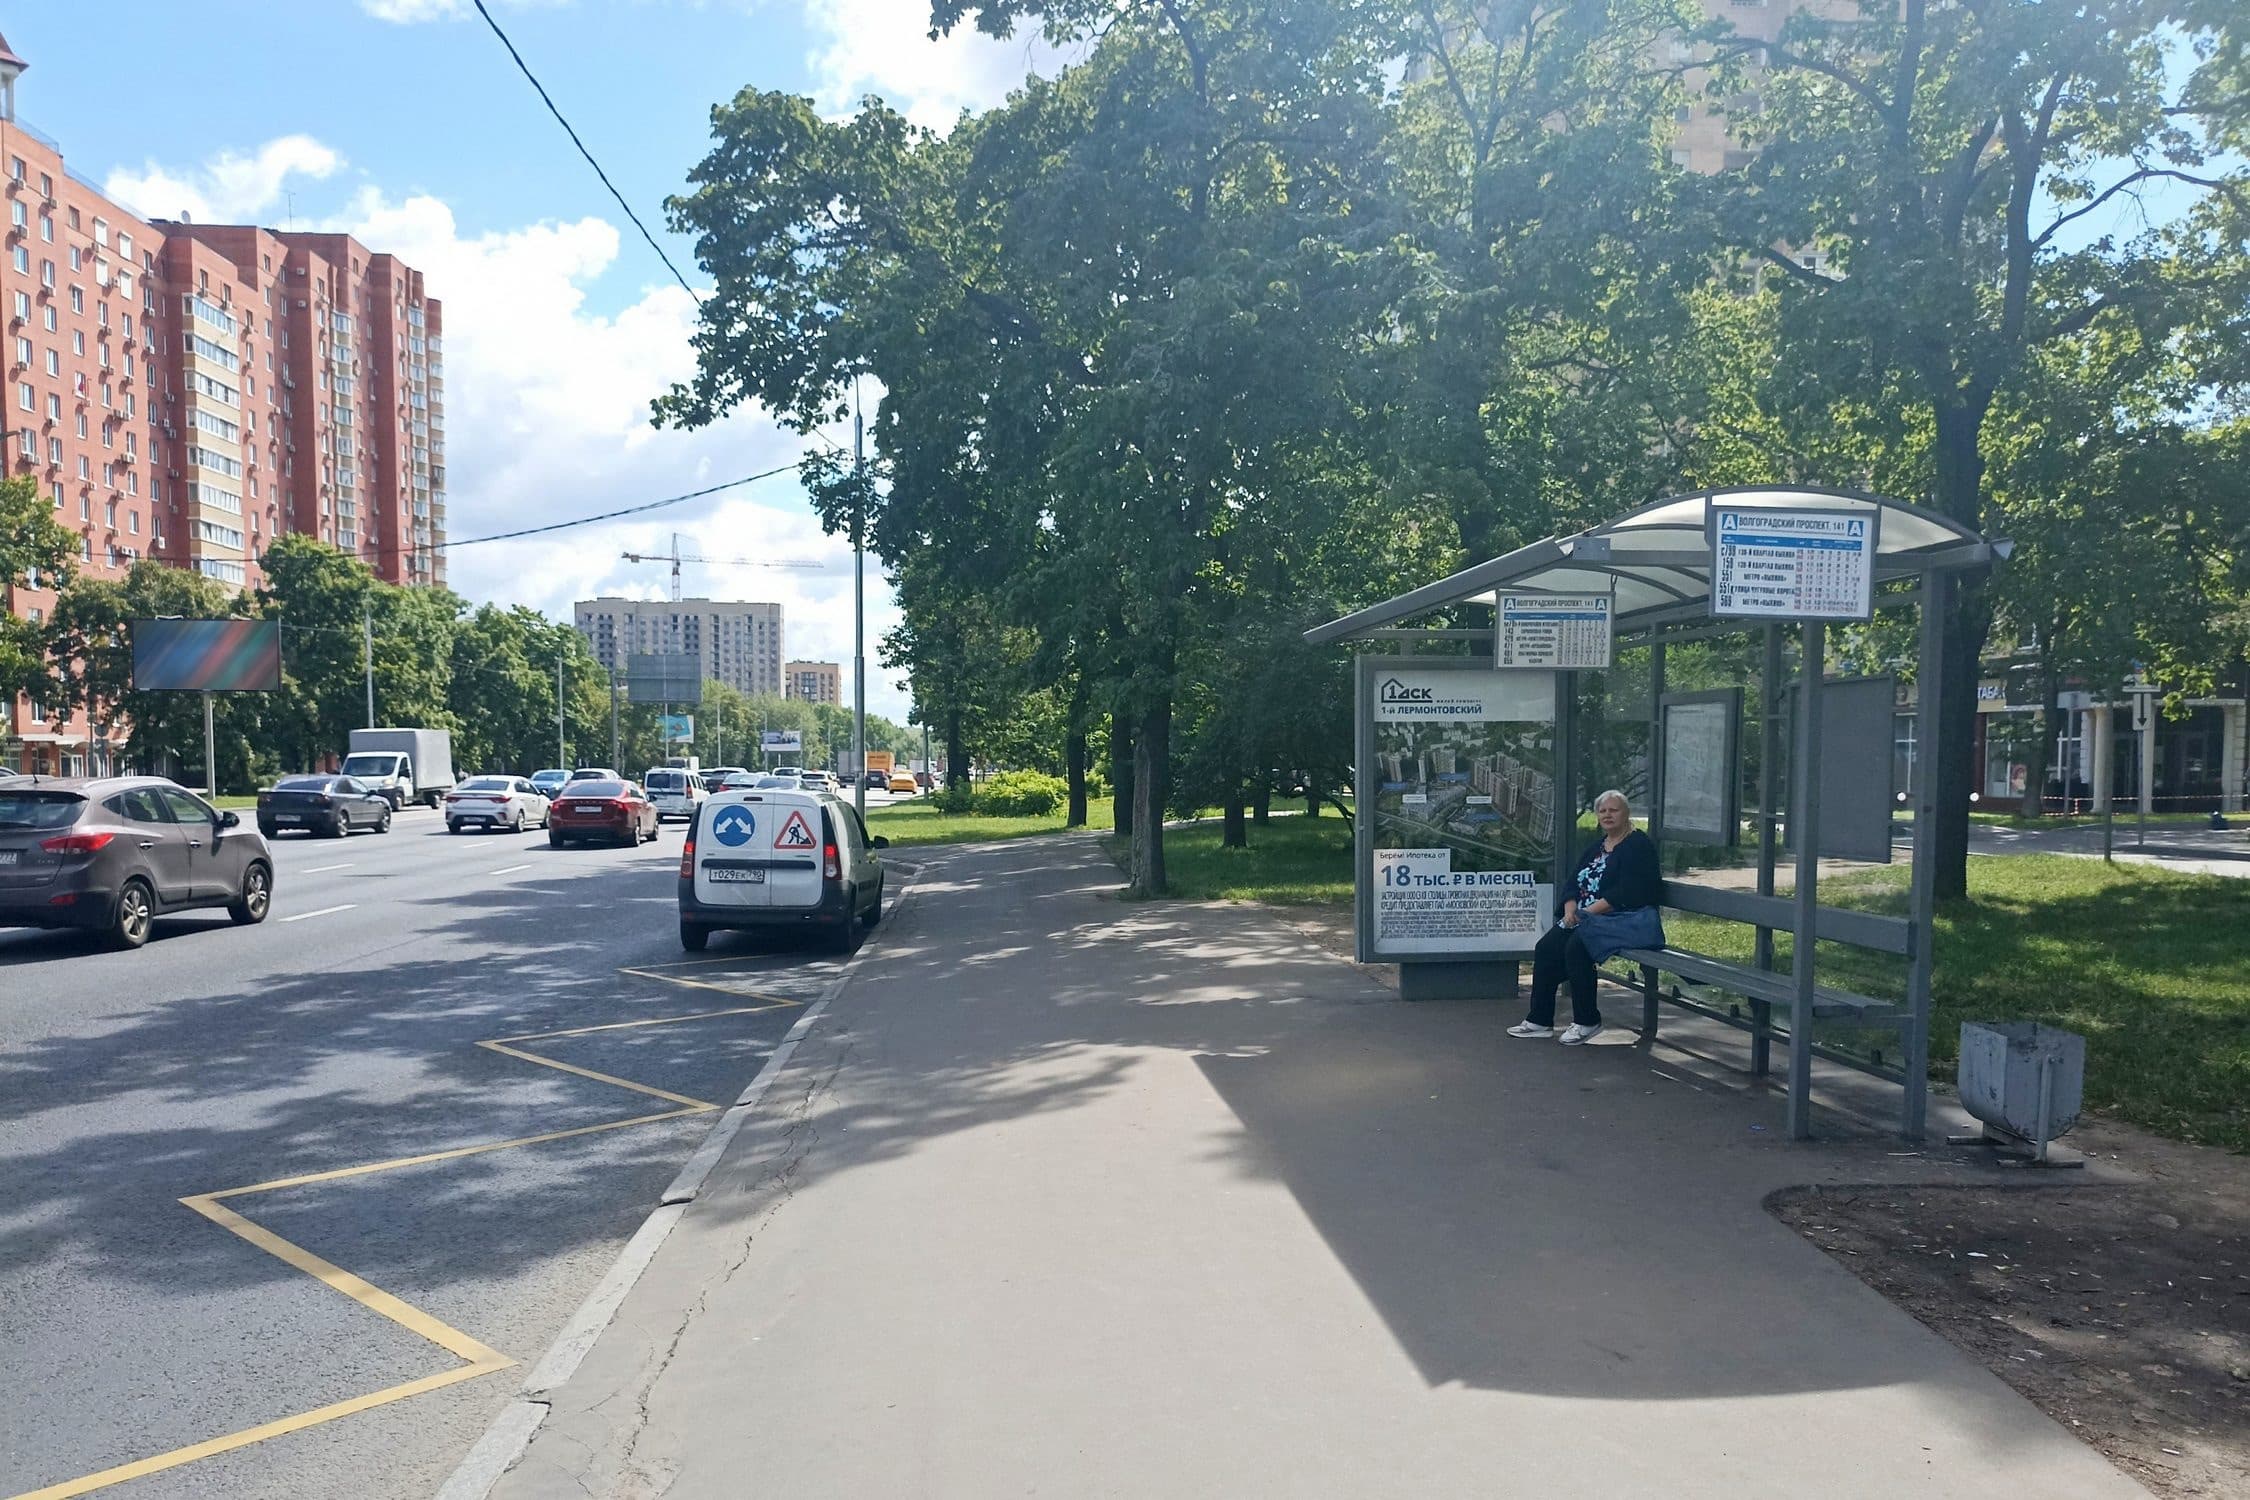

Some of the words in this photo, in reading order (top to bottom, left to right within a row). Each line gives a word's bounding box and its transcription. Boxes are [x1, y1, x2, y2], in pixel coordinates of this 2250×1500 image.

[1739, 516, 1796, 529] ВОЛГОГРАДСКИЙ
[1833, 521, 1845, 531] 141
[1721, 569, 1733, 582] 551
[1397, 704, 1482, 714] ЛЕРМОНТОВСКИЙ
[1381, 865, 1411, 887] 18
[1414, 873, 1450, 886] тыс.
[1465, 874, 1475, 885] в
